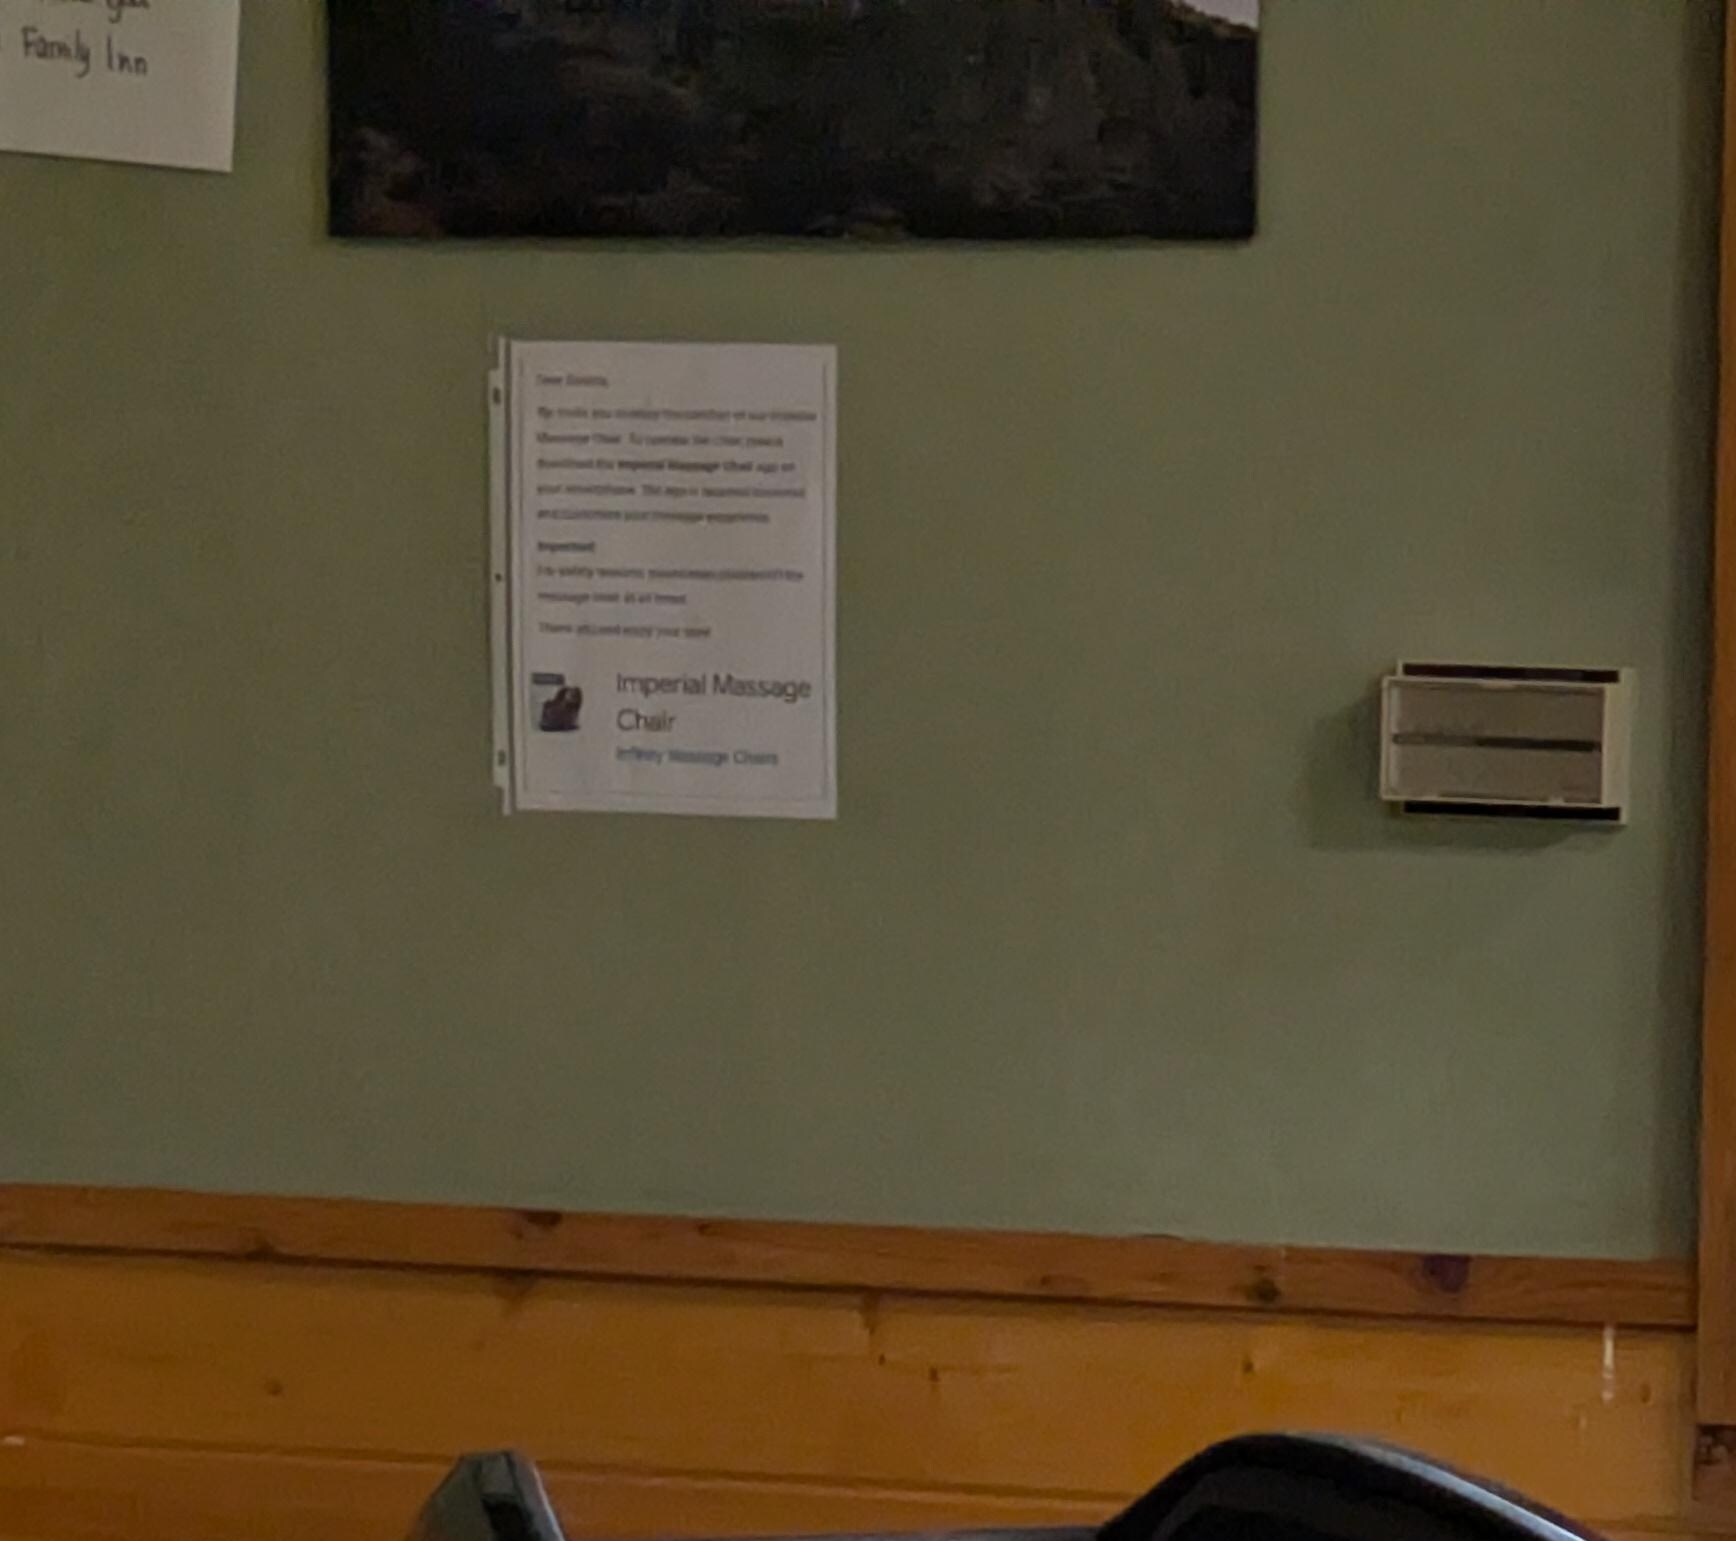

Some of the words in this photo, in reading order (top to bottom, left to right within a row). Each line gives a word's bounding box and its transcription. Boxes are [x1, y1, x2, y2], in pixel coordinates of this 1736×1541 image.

[106, 35, 149, 76] Inn
[616, 672, 706, 698] Imperial
[712, 674, 812, 703] Massage
[616, 708, 677, 732] Chair
